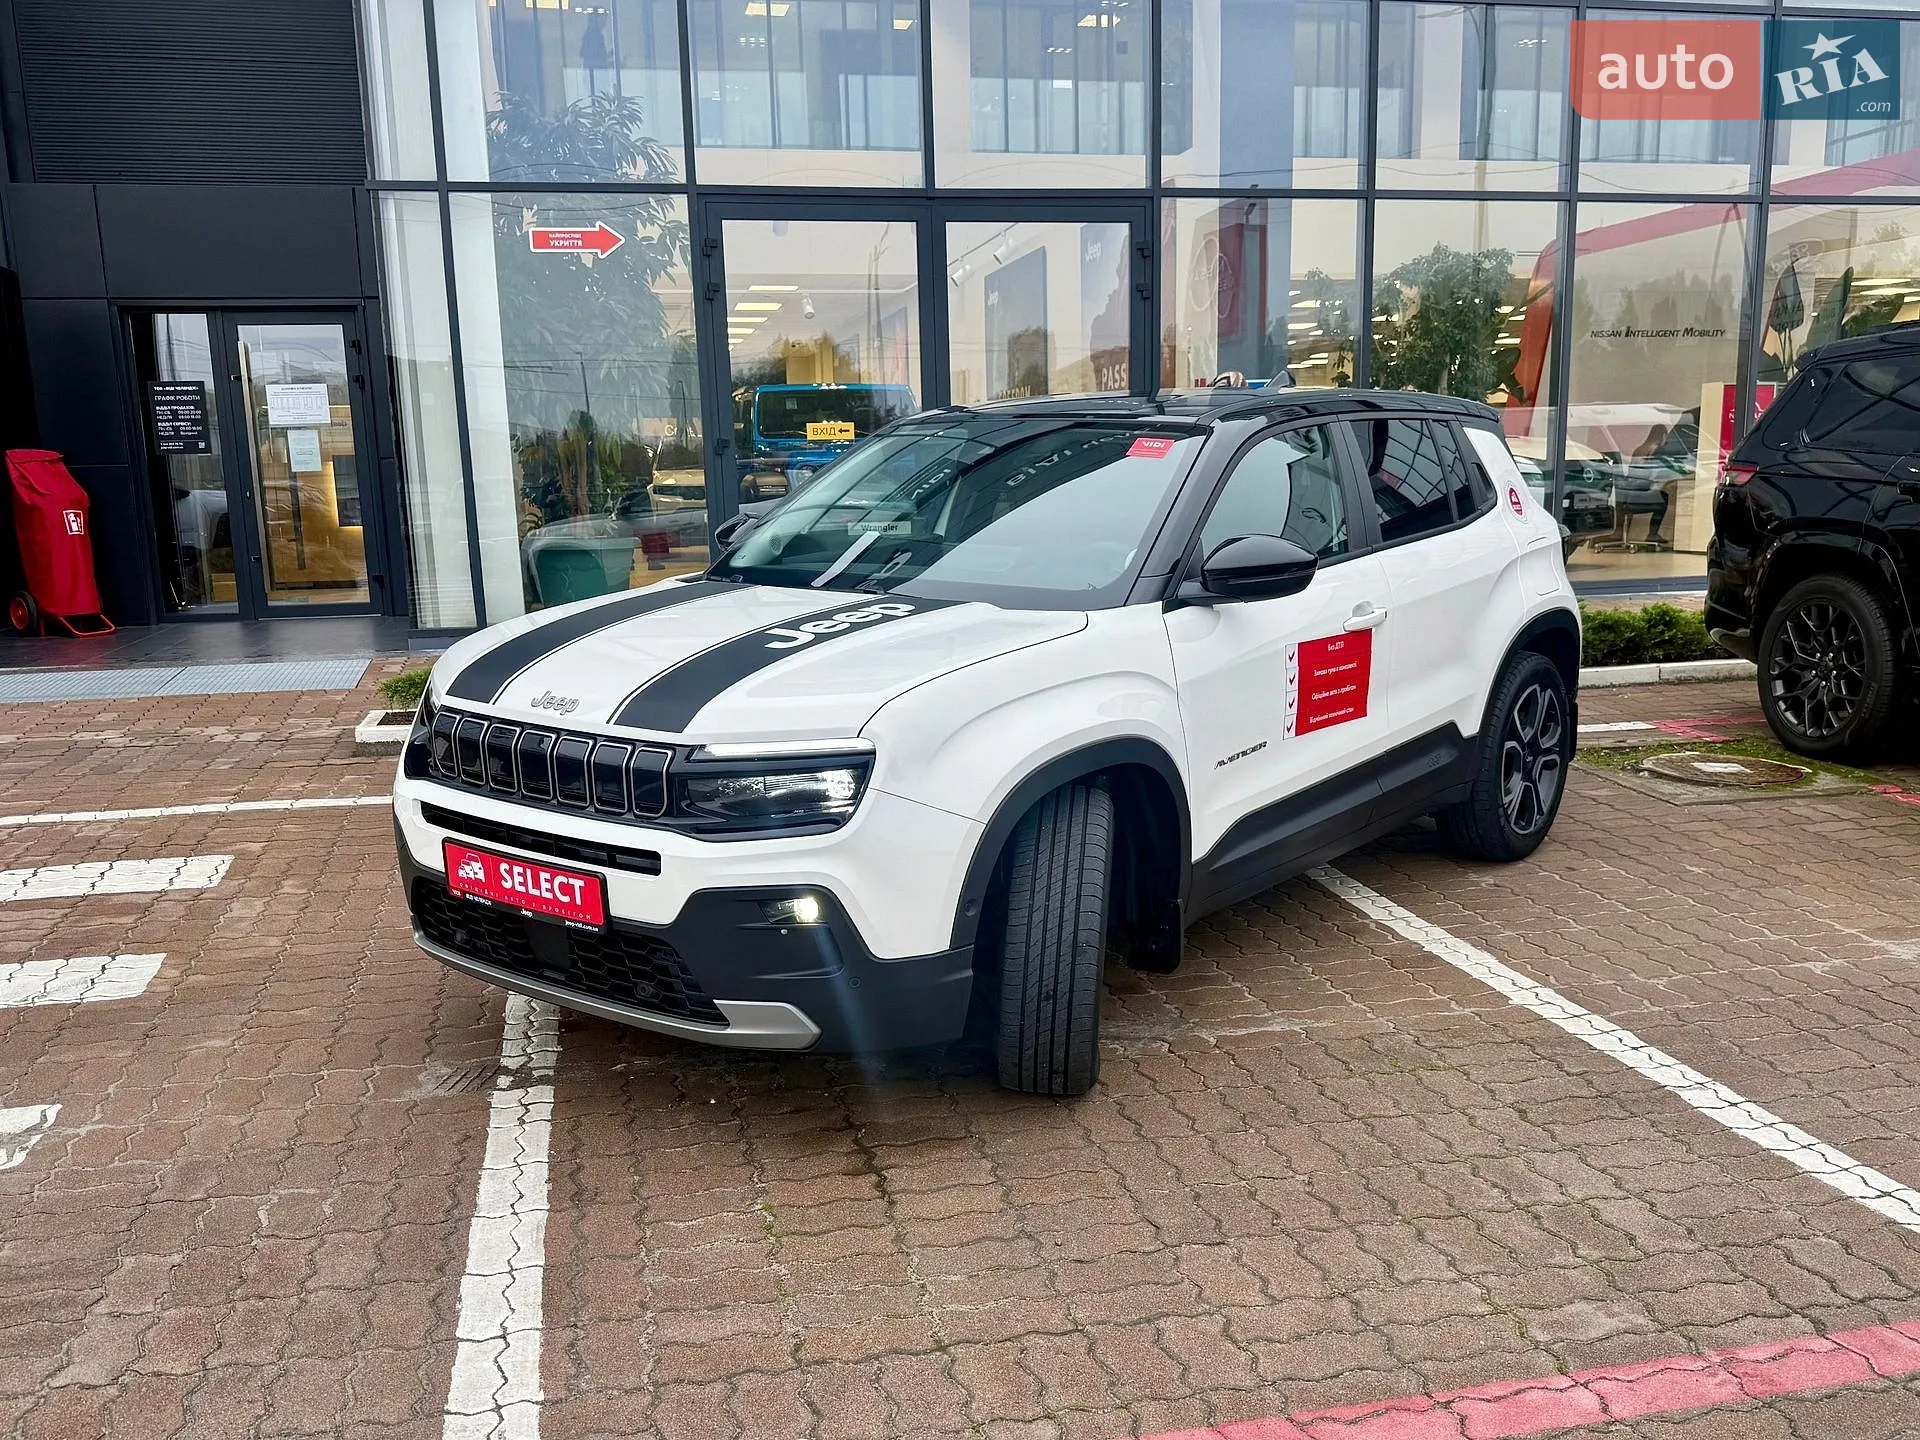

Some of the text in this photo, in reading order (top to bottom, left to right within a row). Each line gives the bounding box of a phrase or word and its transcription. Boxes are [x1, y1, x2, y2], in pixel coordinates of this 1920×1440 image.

[549, 239, 583, 247] УКРИТТЯ
[1590, 330, 1622, 338] NISSAN
[812, 427, 837, 436] ВХІД
[861, 522, 899, 533] Wrangler
[764, 603, 917, 649] Jeep
[531, 690, 580, 716] Jeep
[1214, 741, 1268, 770] AVENGER
[499, 862, 585, 906] SELECT
[520, 908, 533, 918] Jeep
